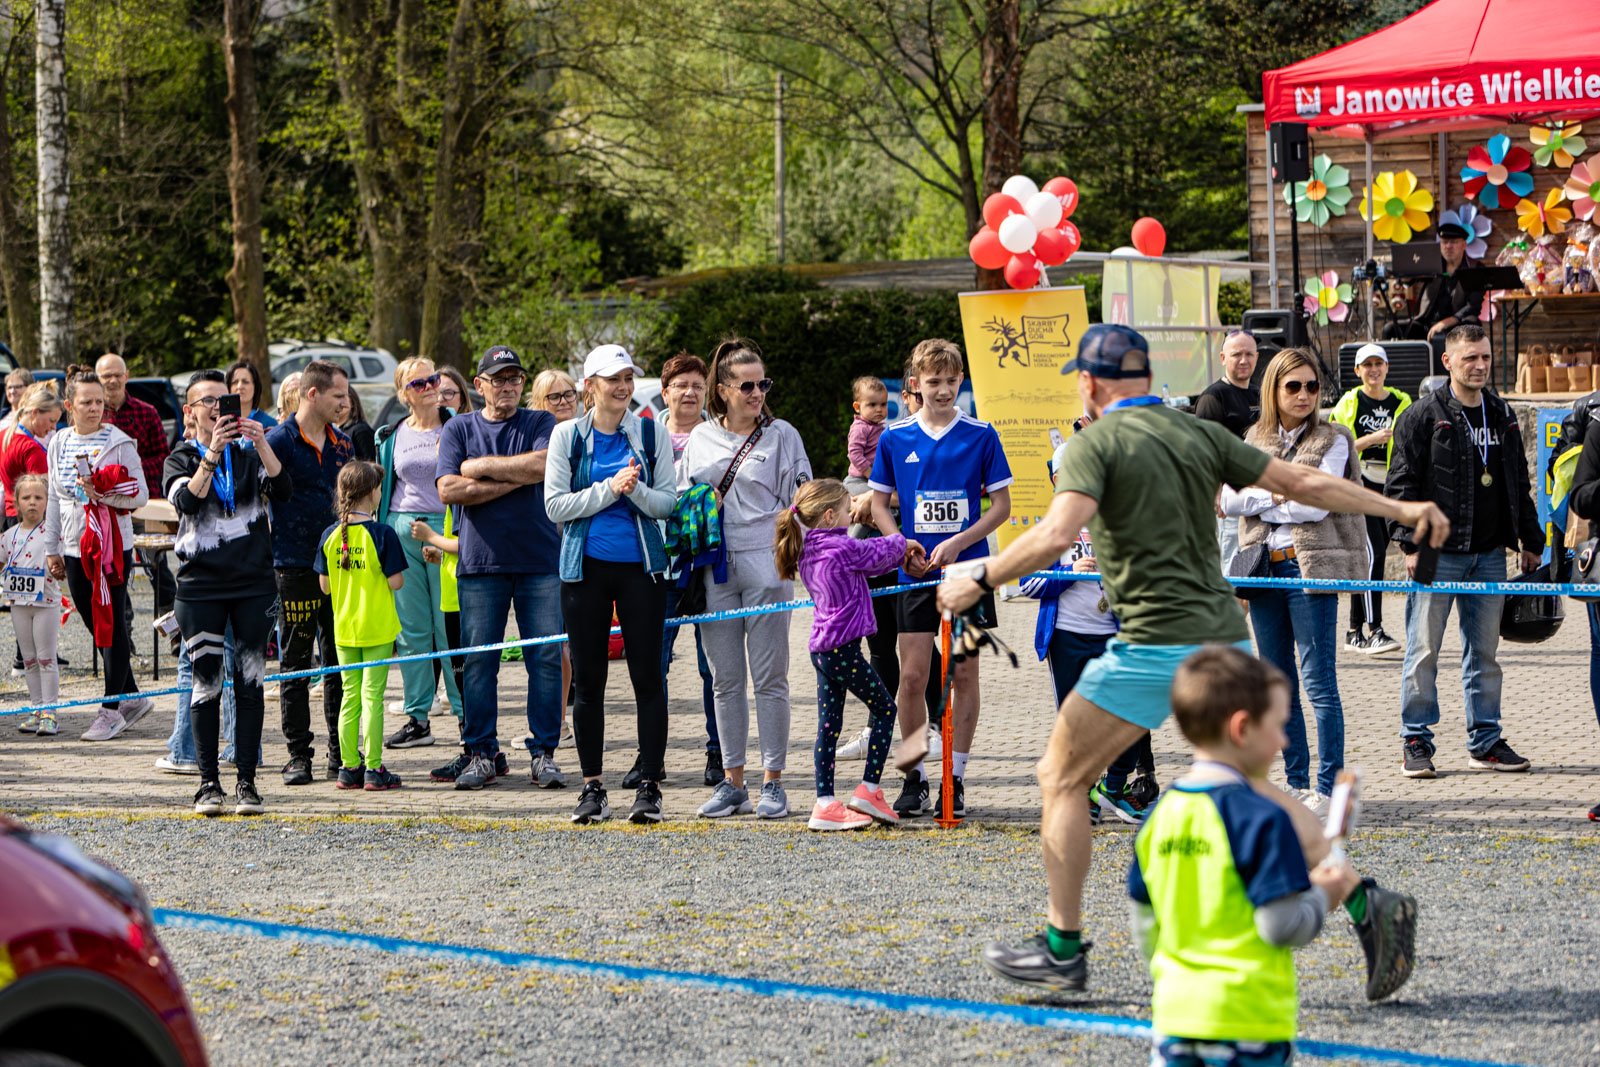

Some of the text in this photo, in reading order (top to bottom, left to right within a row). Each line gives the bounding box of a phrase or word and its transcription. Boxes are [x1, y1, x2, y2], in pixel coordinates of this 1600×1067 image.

[1328, 66, 1600, 116] Janowice Wielkie
[994, 419, 1018, 427] MAPA
[923, 501, 959, 521] 356
[10, 576, 36, 592] 339
